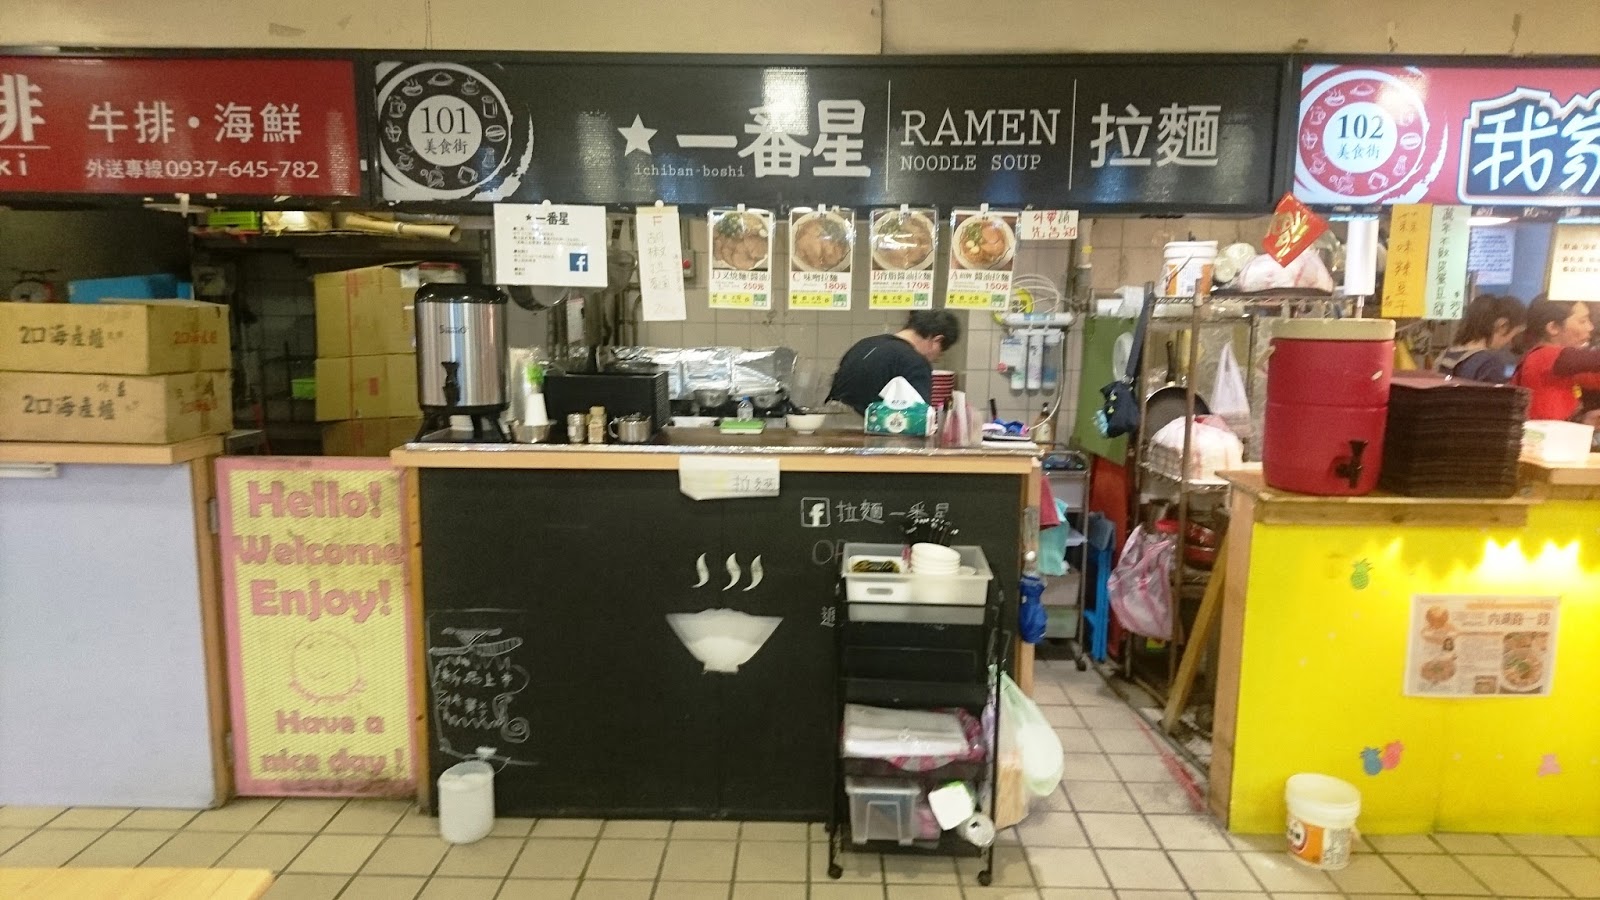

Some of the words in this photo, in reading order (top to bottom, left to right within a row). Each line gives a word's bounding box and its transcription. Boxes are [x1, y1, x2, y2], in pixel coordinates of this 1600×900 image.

[420, 106, 471, 134] 101
[901, 109, 1060, 146] RAMEN
[1337, 113, 1384, 139] 102
[424, 138, 469, 156] 美食街
[676, 99, 872, 178] 一番星
[1090, 103, 1222, 167] 拉麵
[900, 155, 978, 171] NOODLE
[991, 155, 1042, 171] SOUP
[1336, 142, 1381, 160] 美食街
[633, 163, 745, 177] ichiban-boshi
[535, 211, 570, 226] 一番星
[247, 480, 382, 519] Hello!
[231, 534, 405, 566] Welcome
[250, 579, 392, 623] Enjoy!
[275, 709, 356, 735] Have
[364, 715, 385, 735] a
[261, 748, 320, 773] nice
